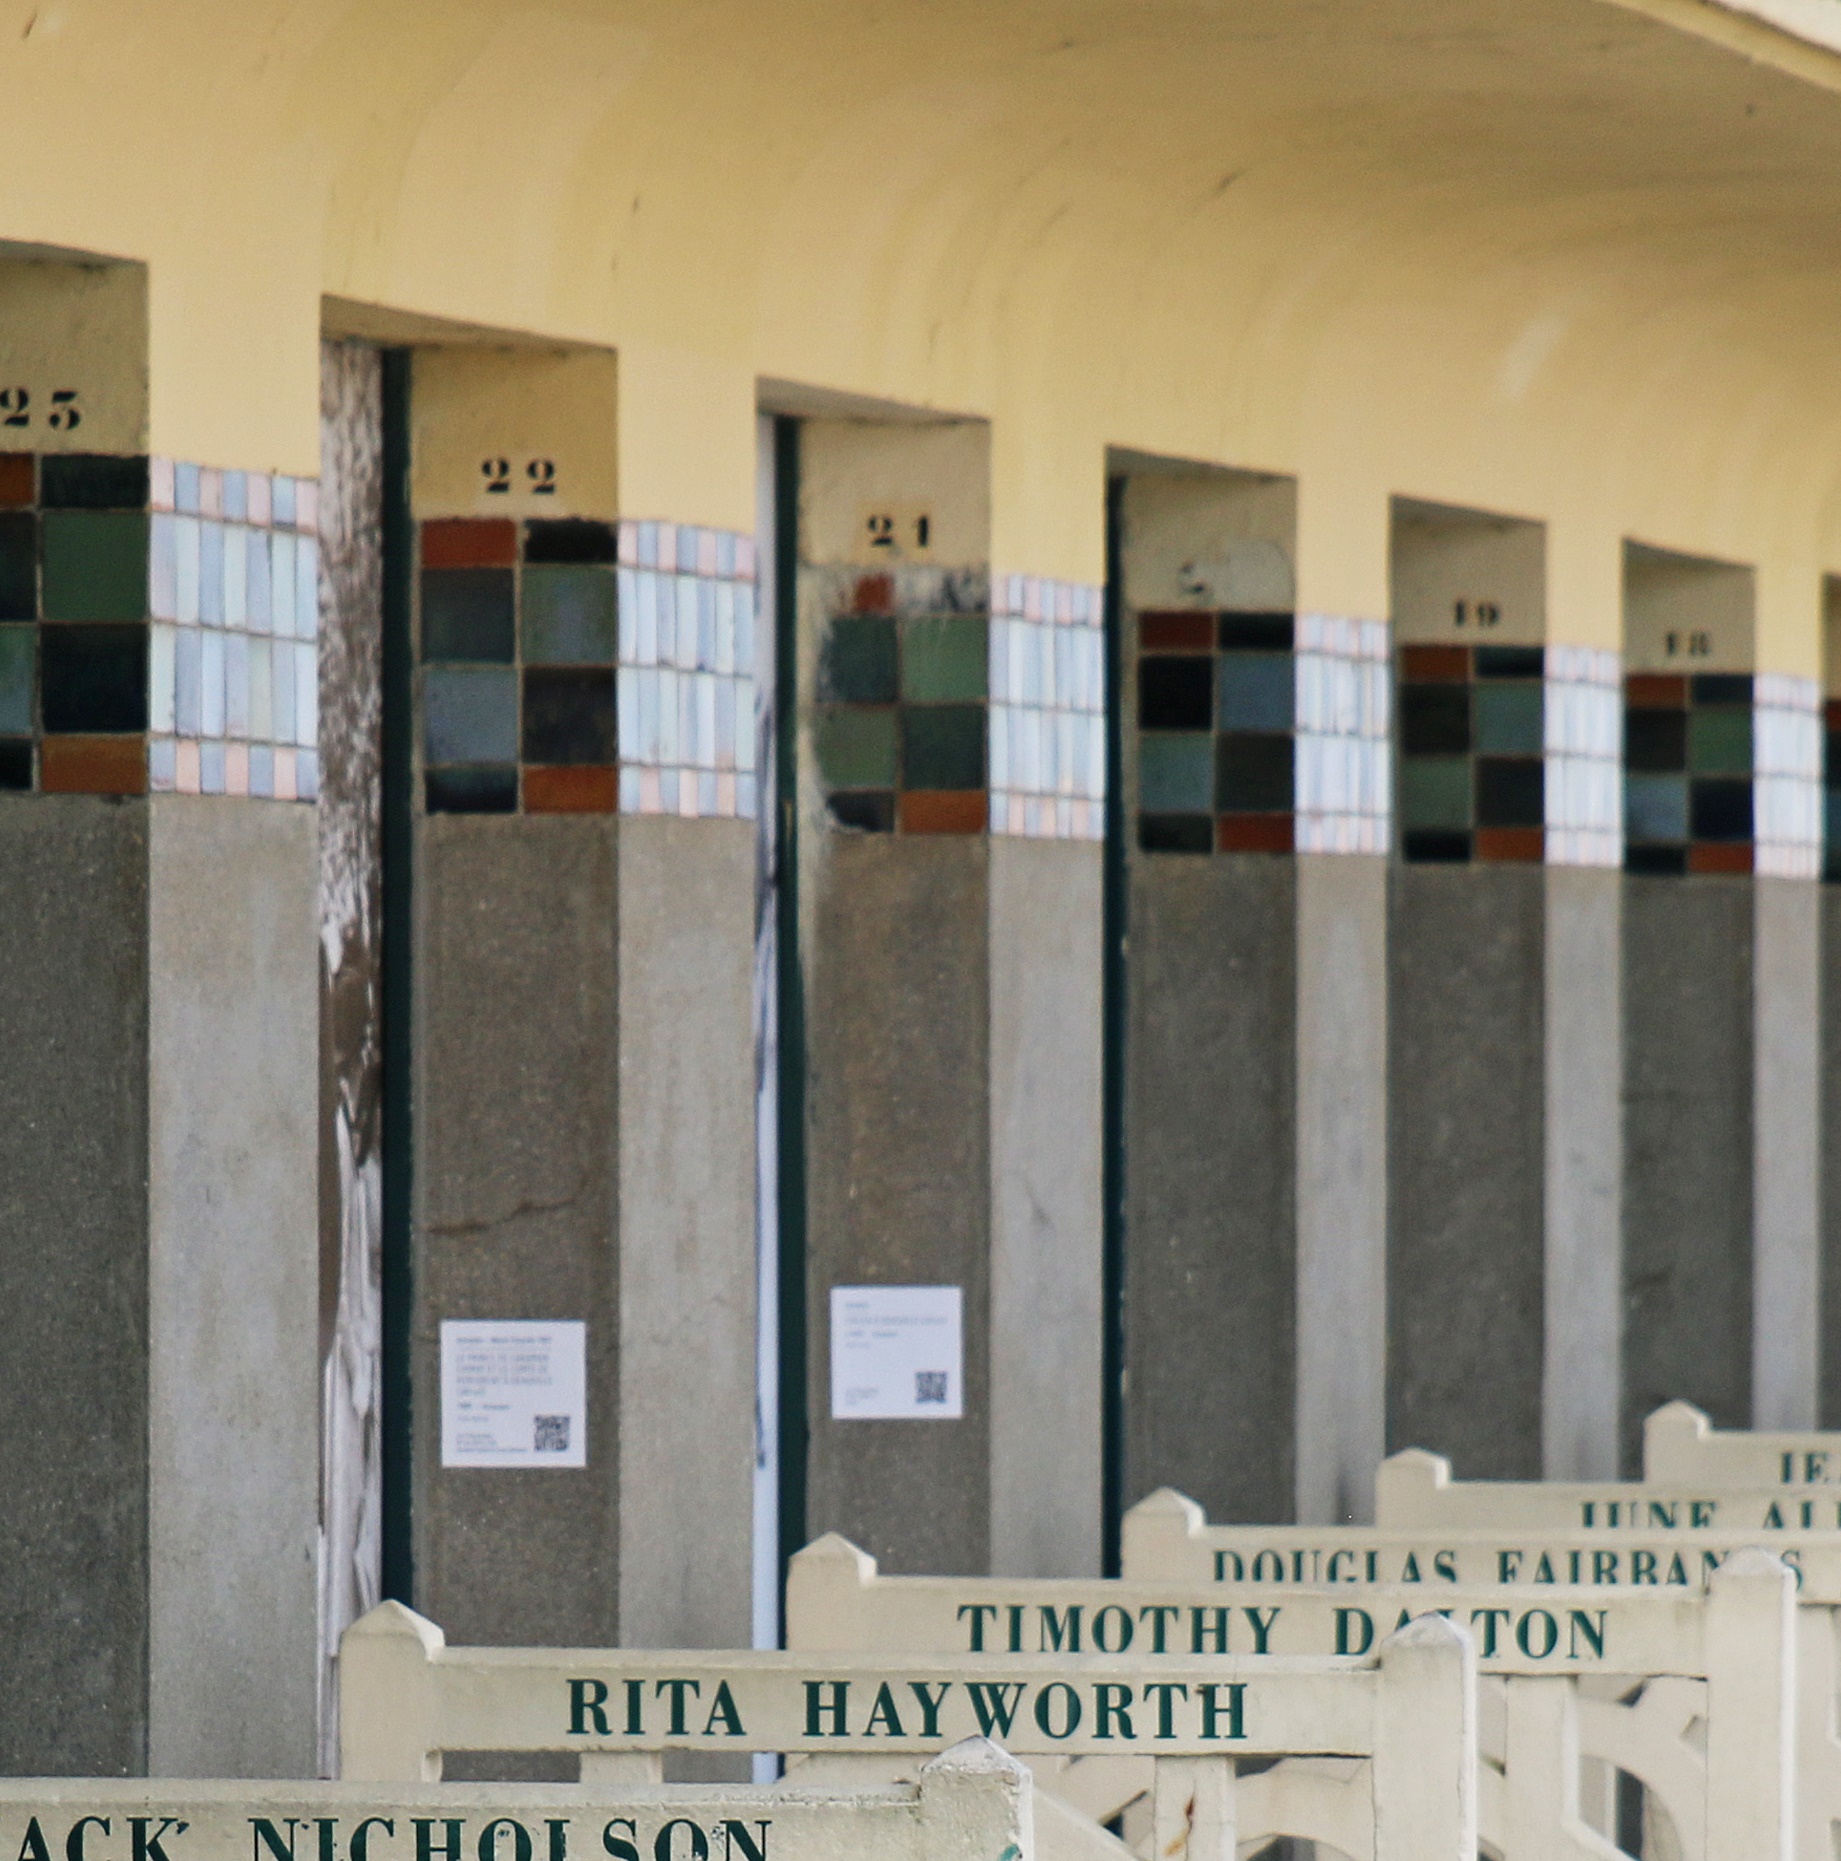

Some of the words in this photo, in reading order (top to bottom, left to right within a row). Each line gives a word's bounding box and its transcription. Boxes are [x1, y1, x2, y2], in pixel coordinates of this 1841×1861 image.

[481, 459, 556, 494] 22
[868, 515, 930, 548] 21
[1454, 600, 1500, 626] 19
[1581, 1500, 1717, 1530] JUNE
[1213, 1549, 1458, 1583] DOUGLAS
[1497, 1550, 1803, 1592] FAIRBANS
[957, 1604, 1281, 1654] TIMOTHY
[1332, 1606, 1609, 1661] DTON
[566, 1678, 747, 1737] RITA
[800, 1680, 1249, 1740] HAYWORTH
